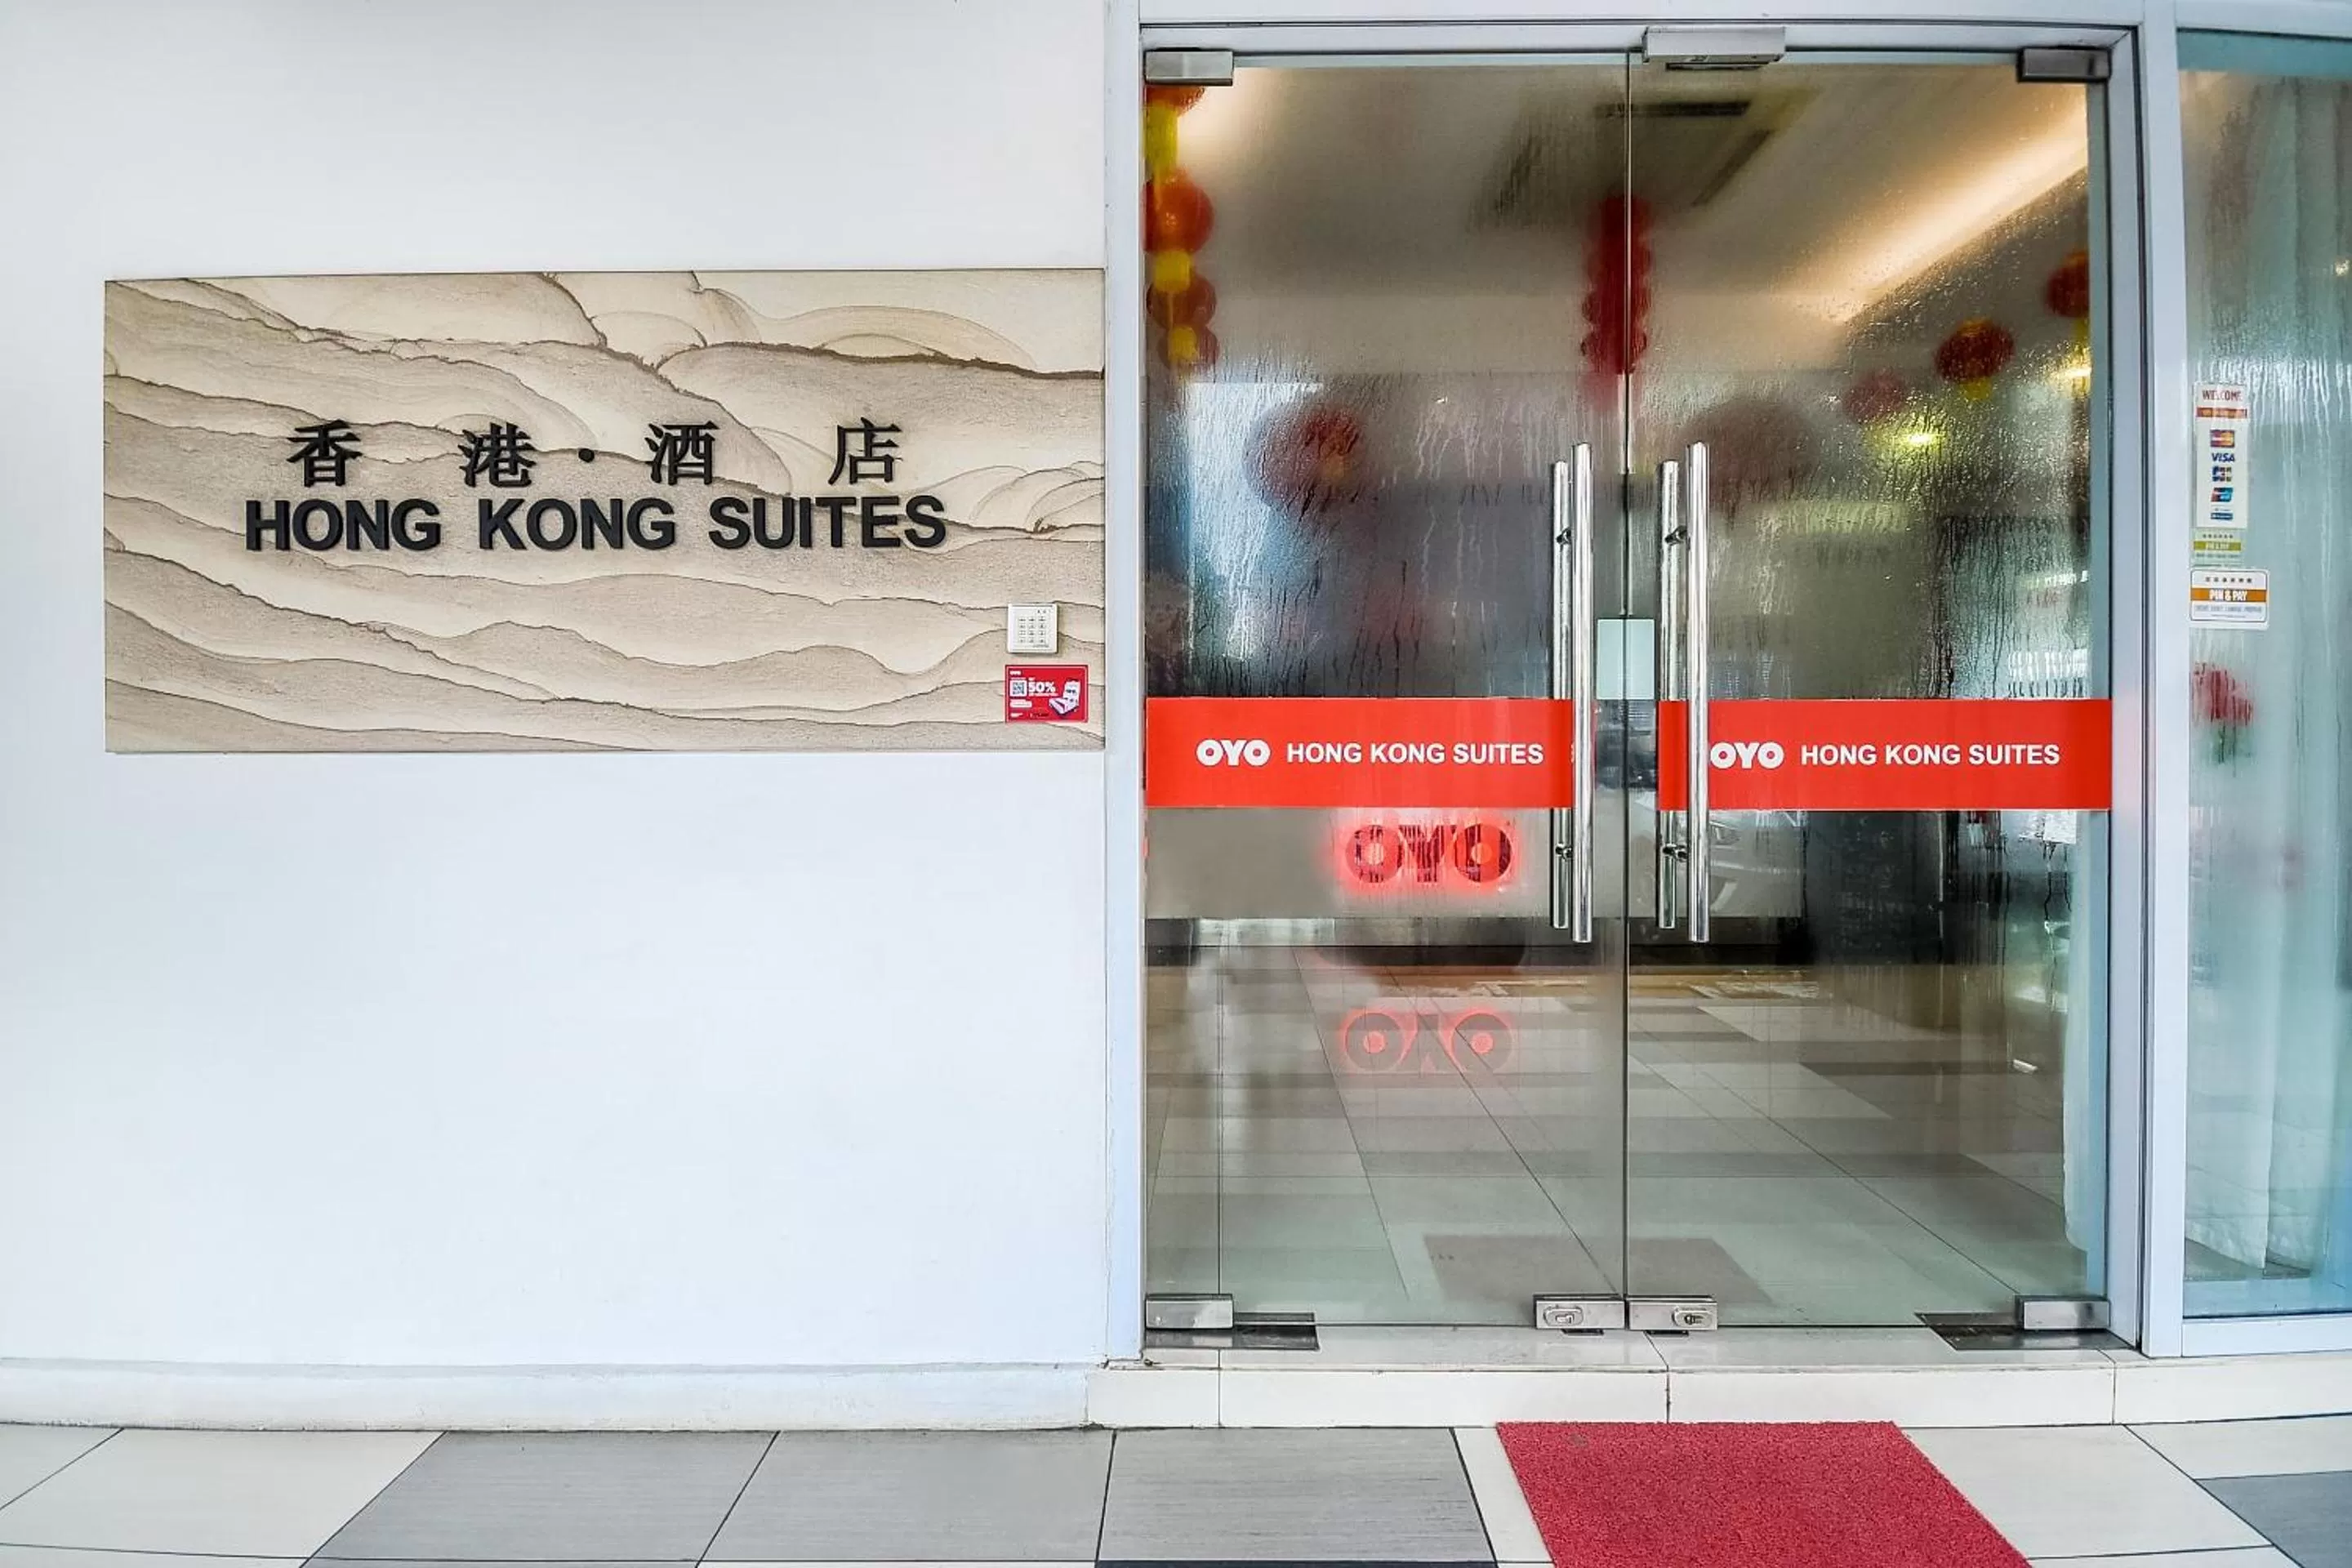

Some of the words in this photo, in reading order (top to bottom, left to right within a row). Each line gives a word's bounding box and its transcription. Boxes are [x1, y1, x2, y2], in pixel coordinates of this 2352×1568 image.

[2211, 452, 2235, 462] VISA
[246, 498, 441, 551] HONG
[479, 497, 675, 550] KONG
[708, 495, 947, 549] SUITES
[2232, 590, 2247, 602] PAY
[1028, 681, 1056, 693] 50%
[1196, 739, 1271, 766] OYO
[1286, 743, 1362, 764] HONG
[1370, 743, 1446, 764] KONG
[1453, 743, 1544, 764] SUITES
[1709, 742, 1784, 768] OYO
[1801, 745, 1878, 764] HONG
[1885, 745, 1961, 764] KONG
[1968, 745, 2060, 764] SUITES
[1345, 823, 1513, 884] OYO
